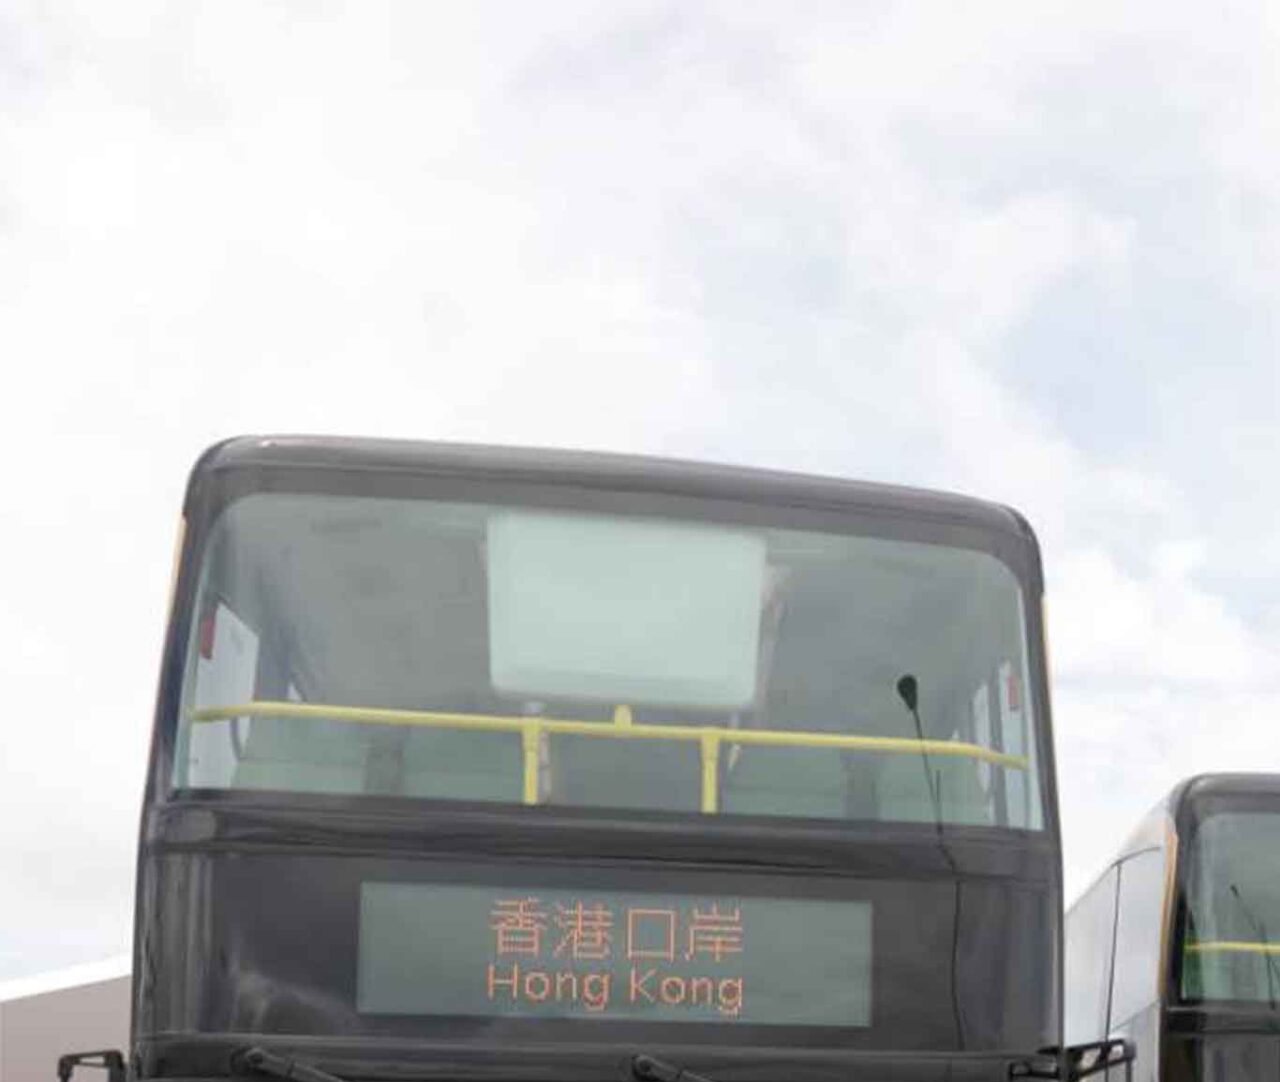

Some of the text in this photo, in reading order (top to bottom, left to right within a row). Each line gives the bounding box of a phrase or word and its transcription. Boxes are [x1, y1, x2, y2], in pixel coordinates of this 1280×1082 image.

[490, 896, 743, 962] 香港口岸
[487, 963, 743, 1015] Hong Kong
